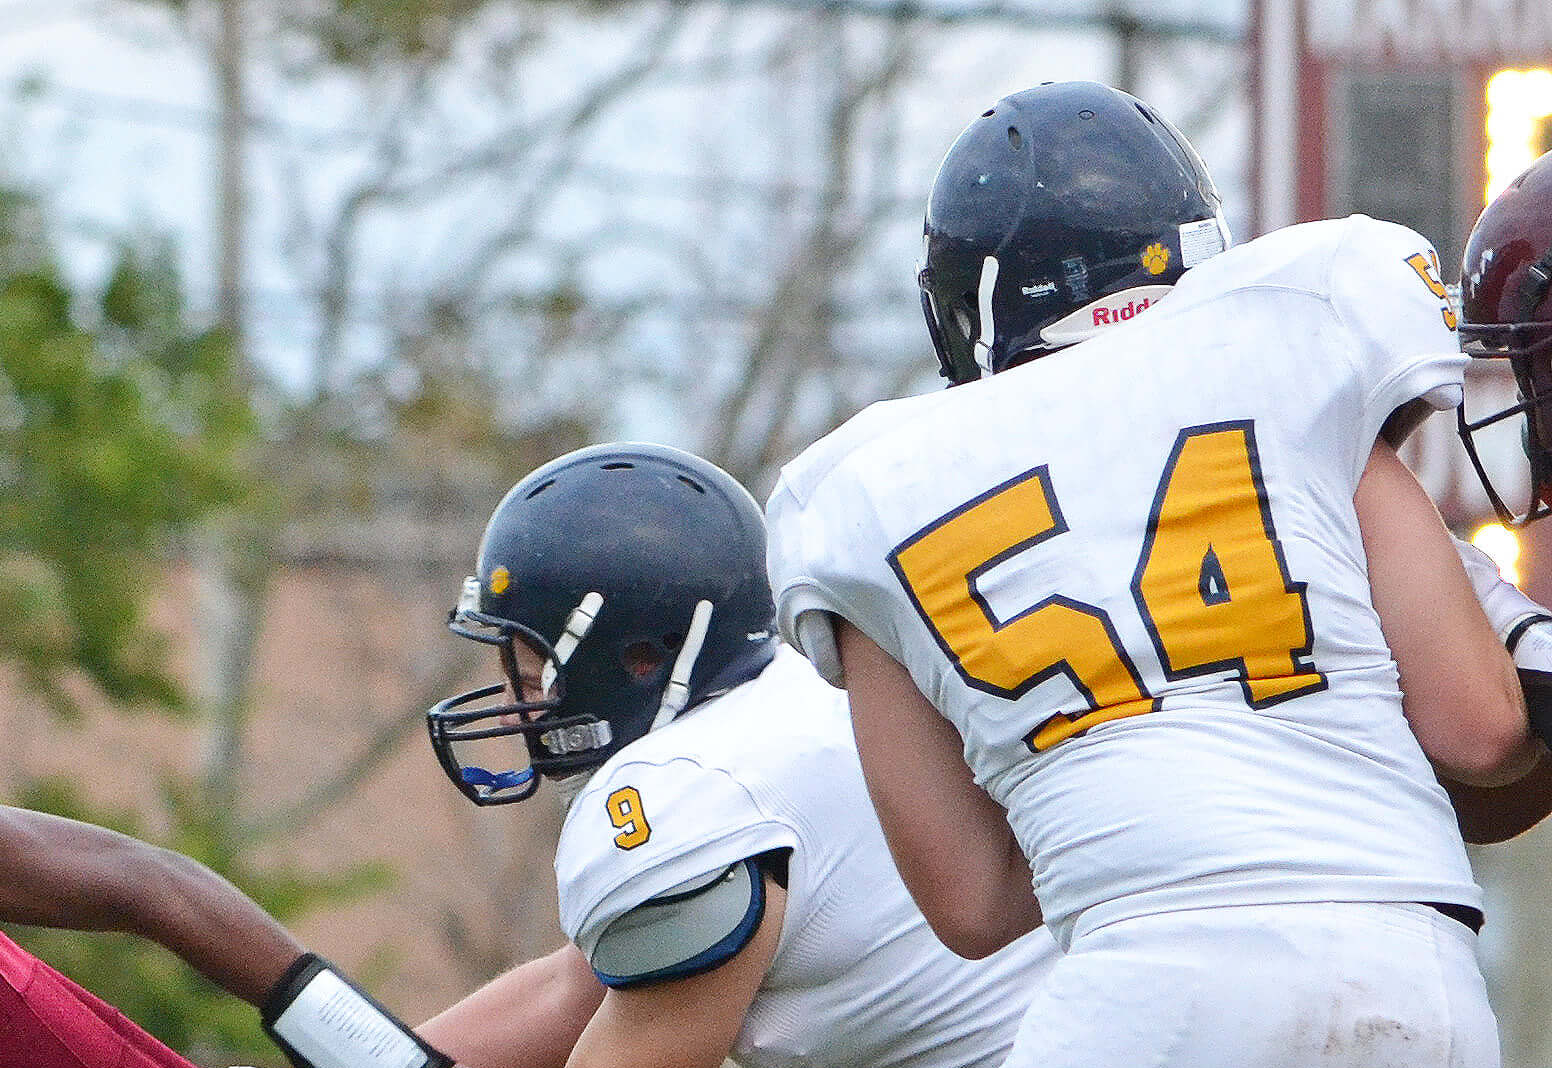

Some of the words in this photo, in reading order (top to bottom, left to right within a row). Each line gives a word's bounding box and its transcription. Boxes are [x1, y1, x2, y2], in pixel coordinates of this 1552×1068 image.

[1092, 298, 1158, 326] Ridd
[886, 419, 1328, 752] 54
[606, 785, 652, 851] 9
